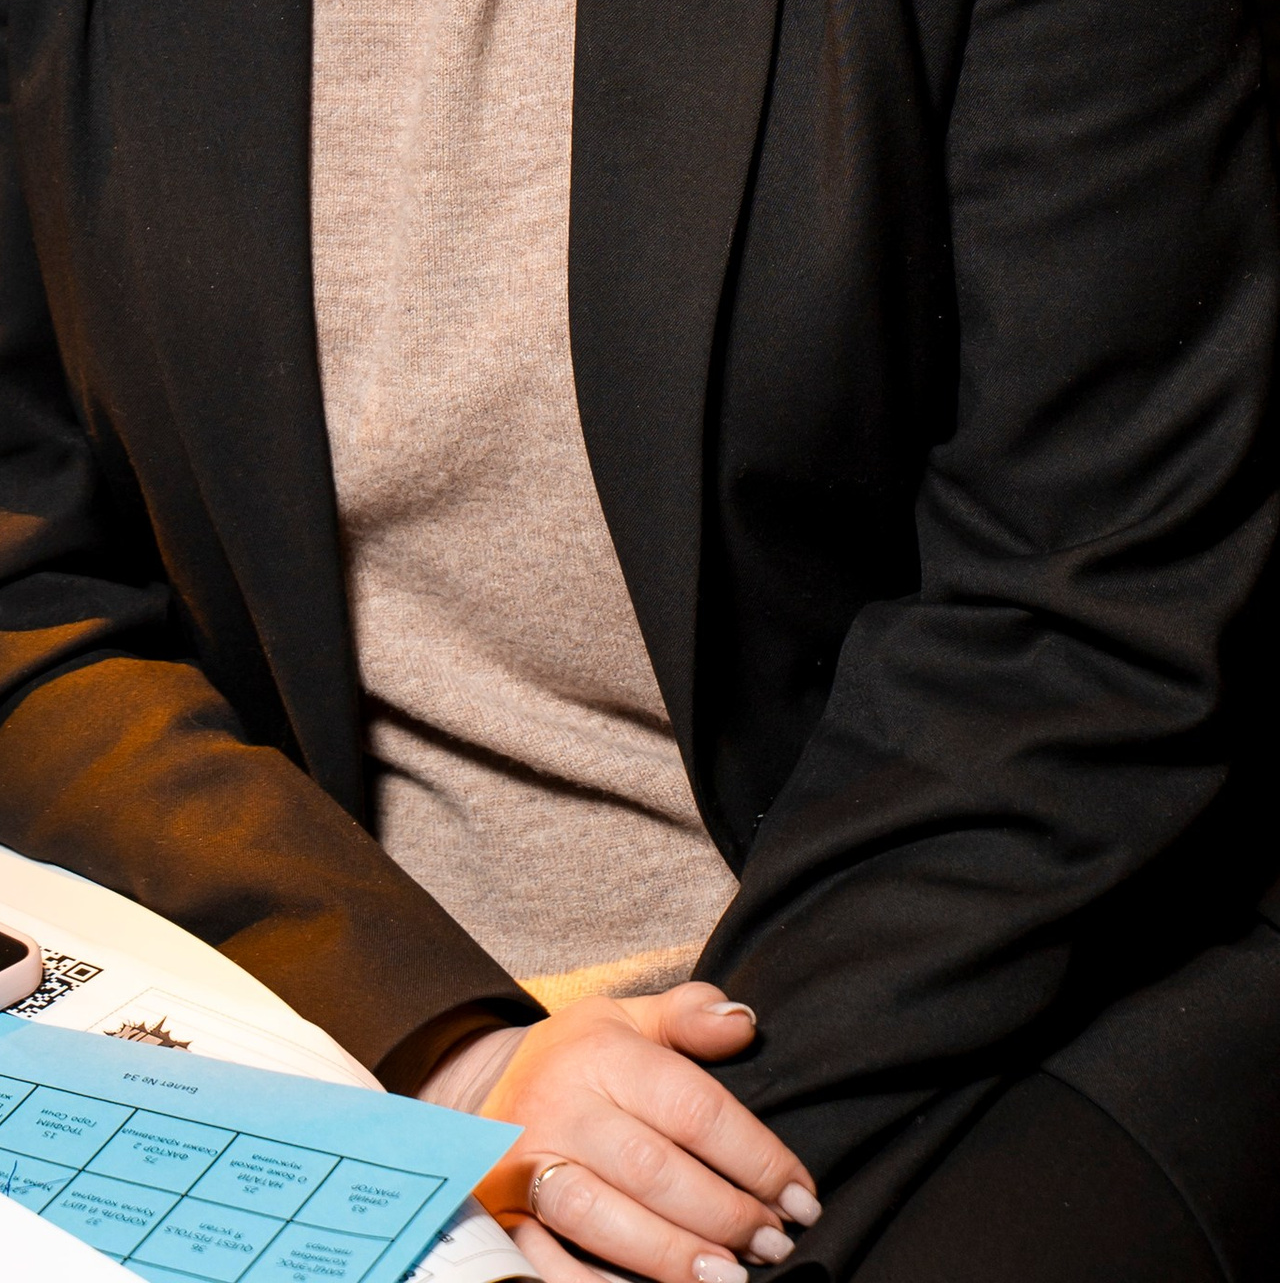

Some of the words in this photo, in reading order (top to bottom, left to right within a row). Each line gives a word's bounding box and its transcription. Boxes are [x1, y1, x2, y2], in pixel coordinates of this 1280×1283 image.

[123, 1073, 140, 1081] 34
[141, 1077, 158, 1085] №
[160, 1081, 198, 1094] Билет
[40, 1109, 68, 1120] Сочи
[36, 1119, 82, 1135] ТРОФИМ
[119, 1127, 179, 1146] красавица
[143, 1146, 188, 1160] ФАКТОР
[182, 1143, 218, 1156] Скажи
[230, 1160, 263, 1172] какой
[237, 1173, 284, 1189] НАТАЛИ
[266, 1169, 295, 1181] боже
[61, 1199, 87, 1211] ШУТ
[71, 1191, 117, 1207] колдуна
[121, 1204, 155, 1216] Кукла
[102, 1210, 147, 1226] КОРОЛЬ
[164, 1226, 213, 1243] PISTOLS
[215, 1239, 253, 1253] QUEST
